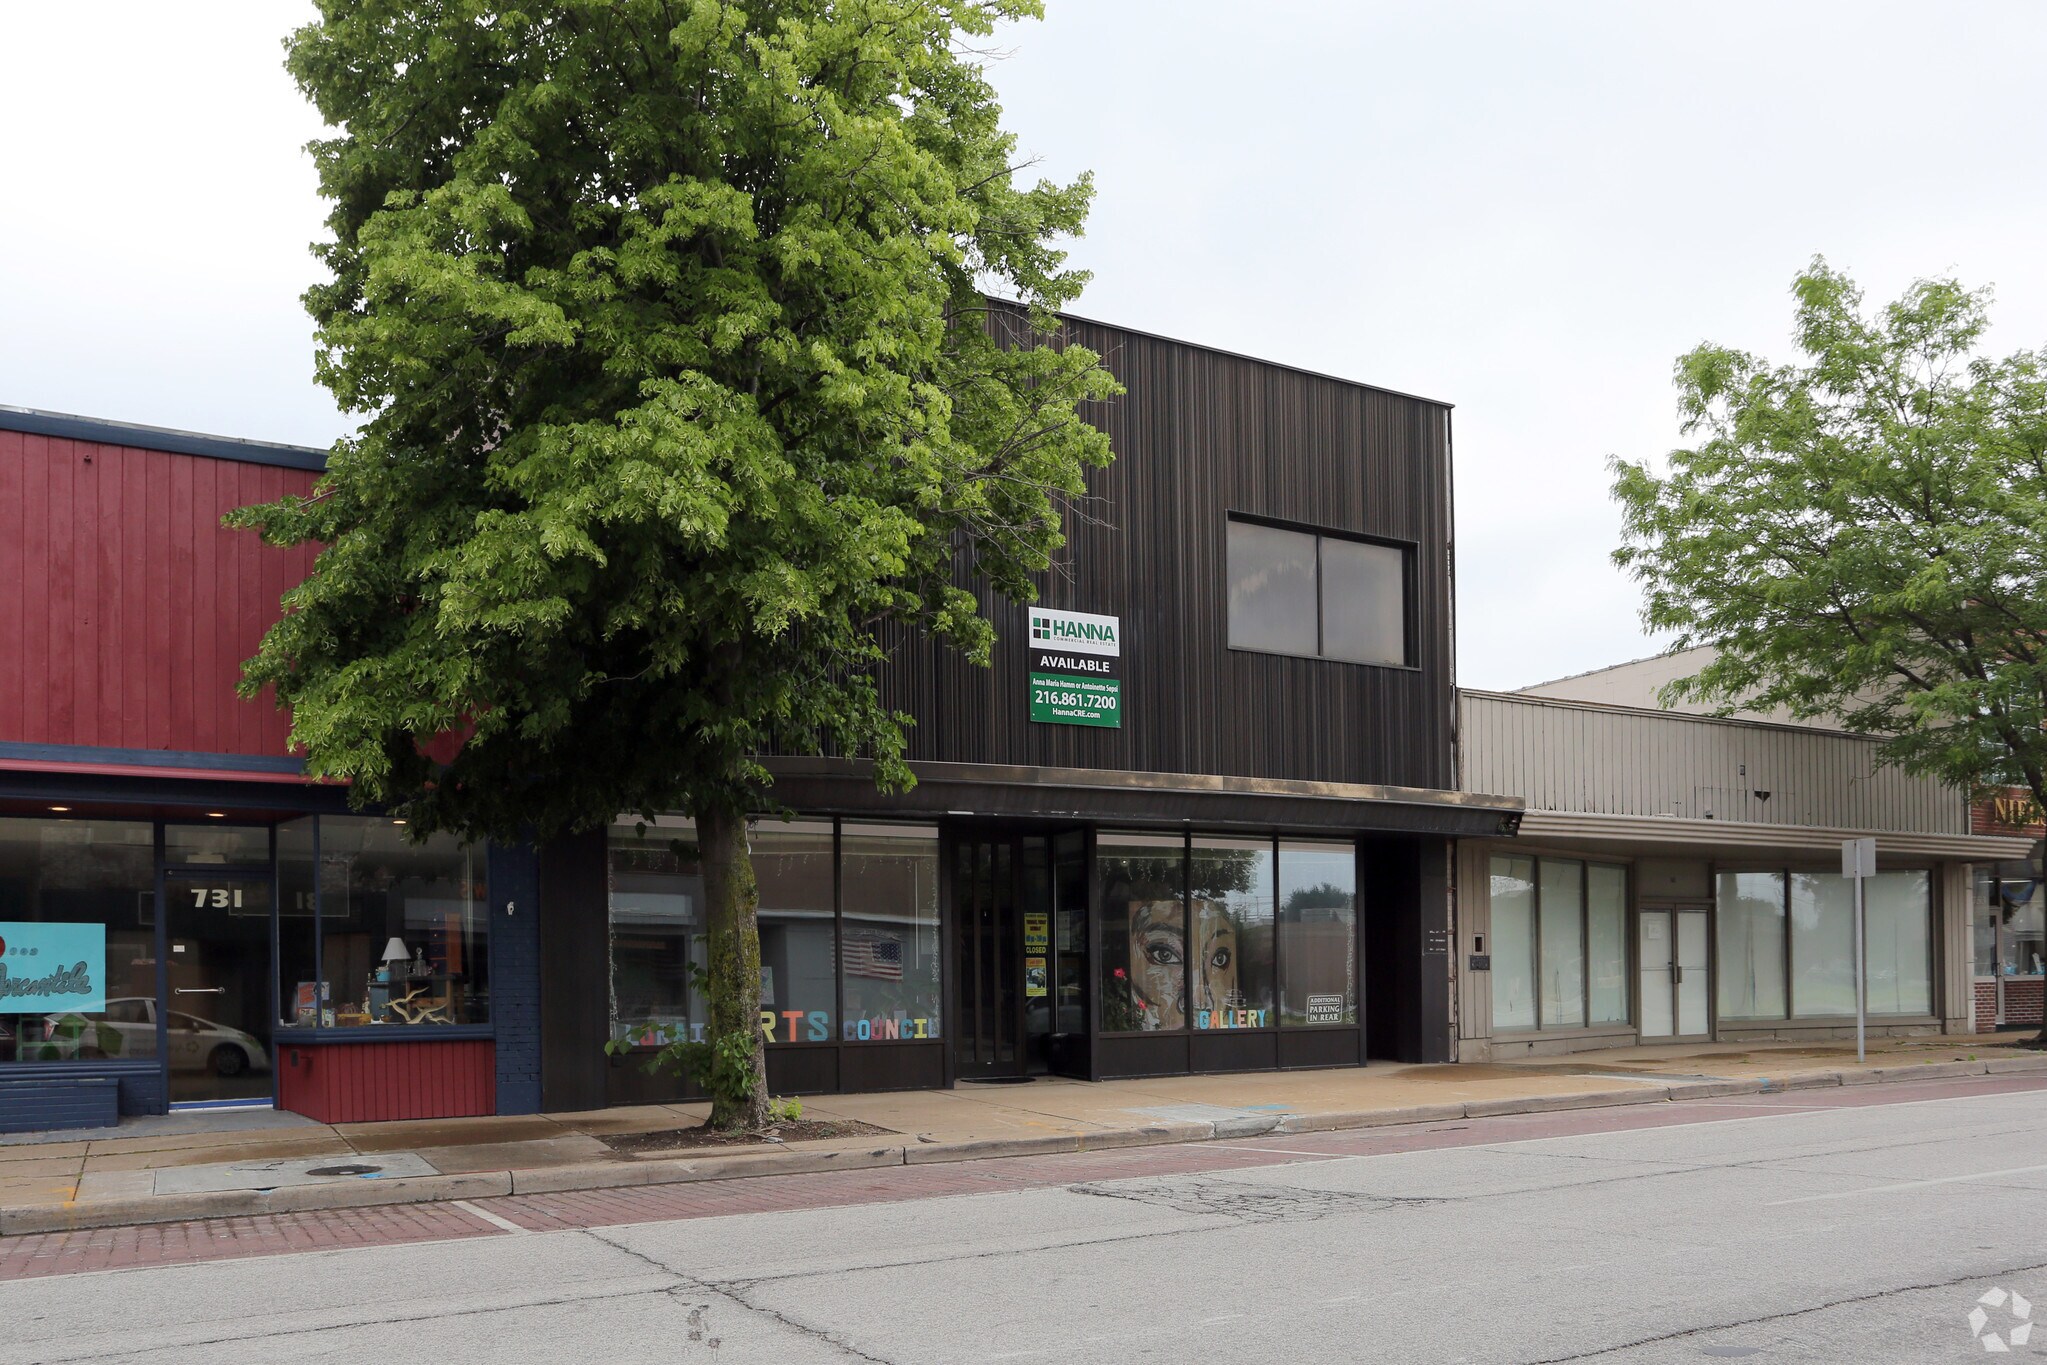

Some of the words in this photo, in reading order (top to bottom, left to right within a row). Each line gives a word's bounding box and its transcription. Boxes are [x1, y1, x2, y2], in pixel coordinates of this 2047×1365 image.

[1053, 619, 1116, 642] HANNA
[1040, 655, 1110, 673] AVAILABLE
[1033, 678, 1045, 686] Anna
[1046, 679, 1059, 687] Maria
[1082, 682, 1105, 691] Antoinette
[1035, 689, 1117, 710] 216.861.7200
[1052, 707, 1101, 719] HannaCRE.com
[190, 888, 243, 908] 731
[1309, 1005, 1340, 1013] PARKING
[1320, 1013, 1339, 1021] REAR
[760, 1010, 829, 1043] RTS
[843, 1018, 941, 1041] COUNCIL
[1199, 1009, 1266, 1030] GALLERY
